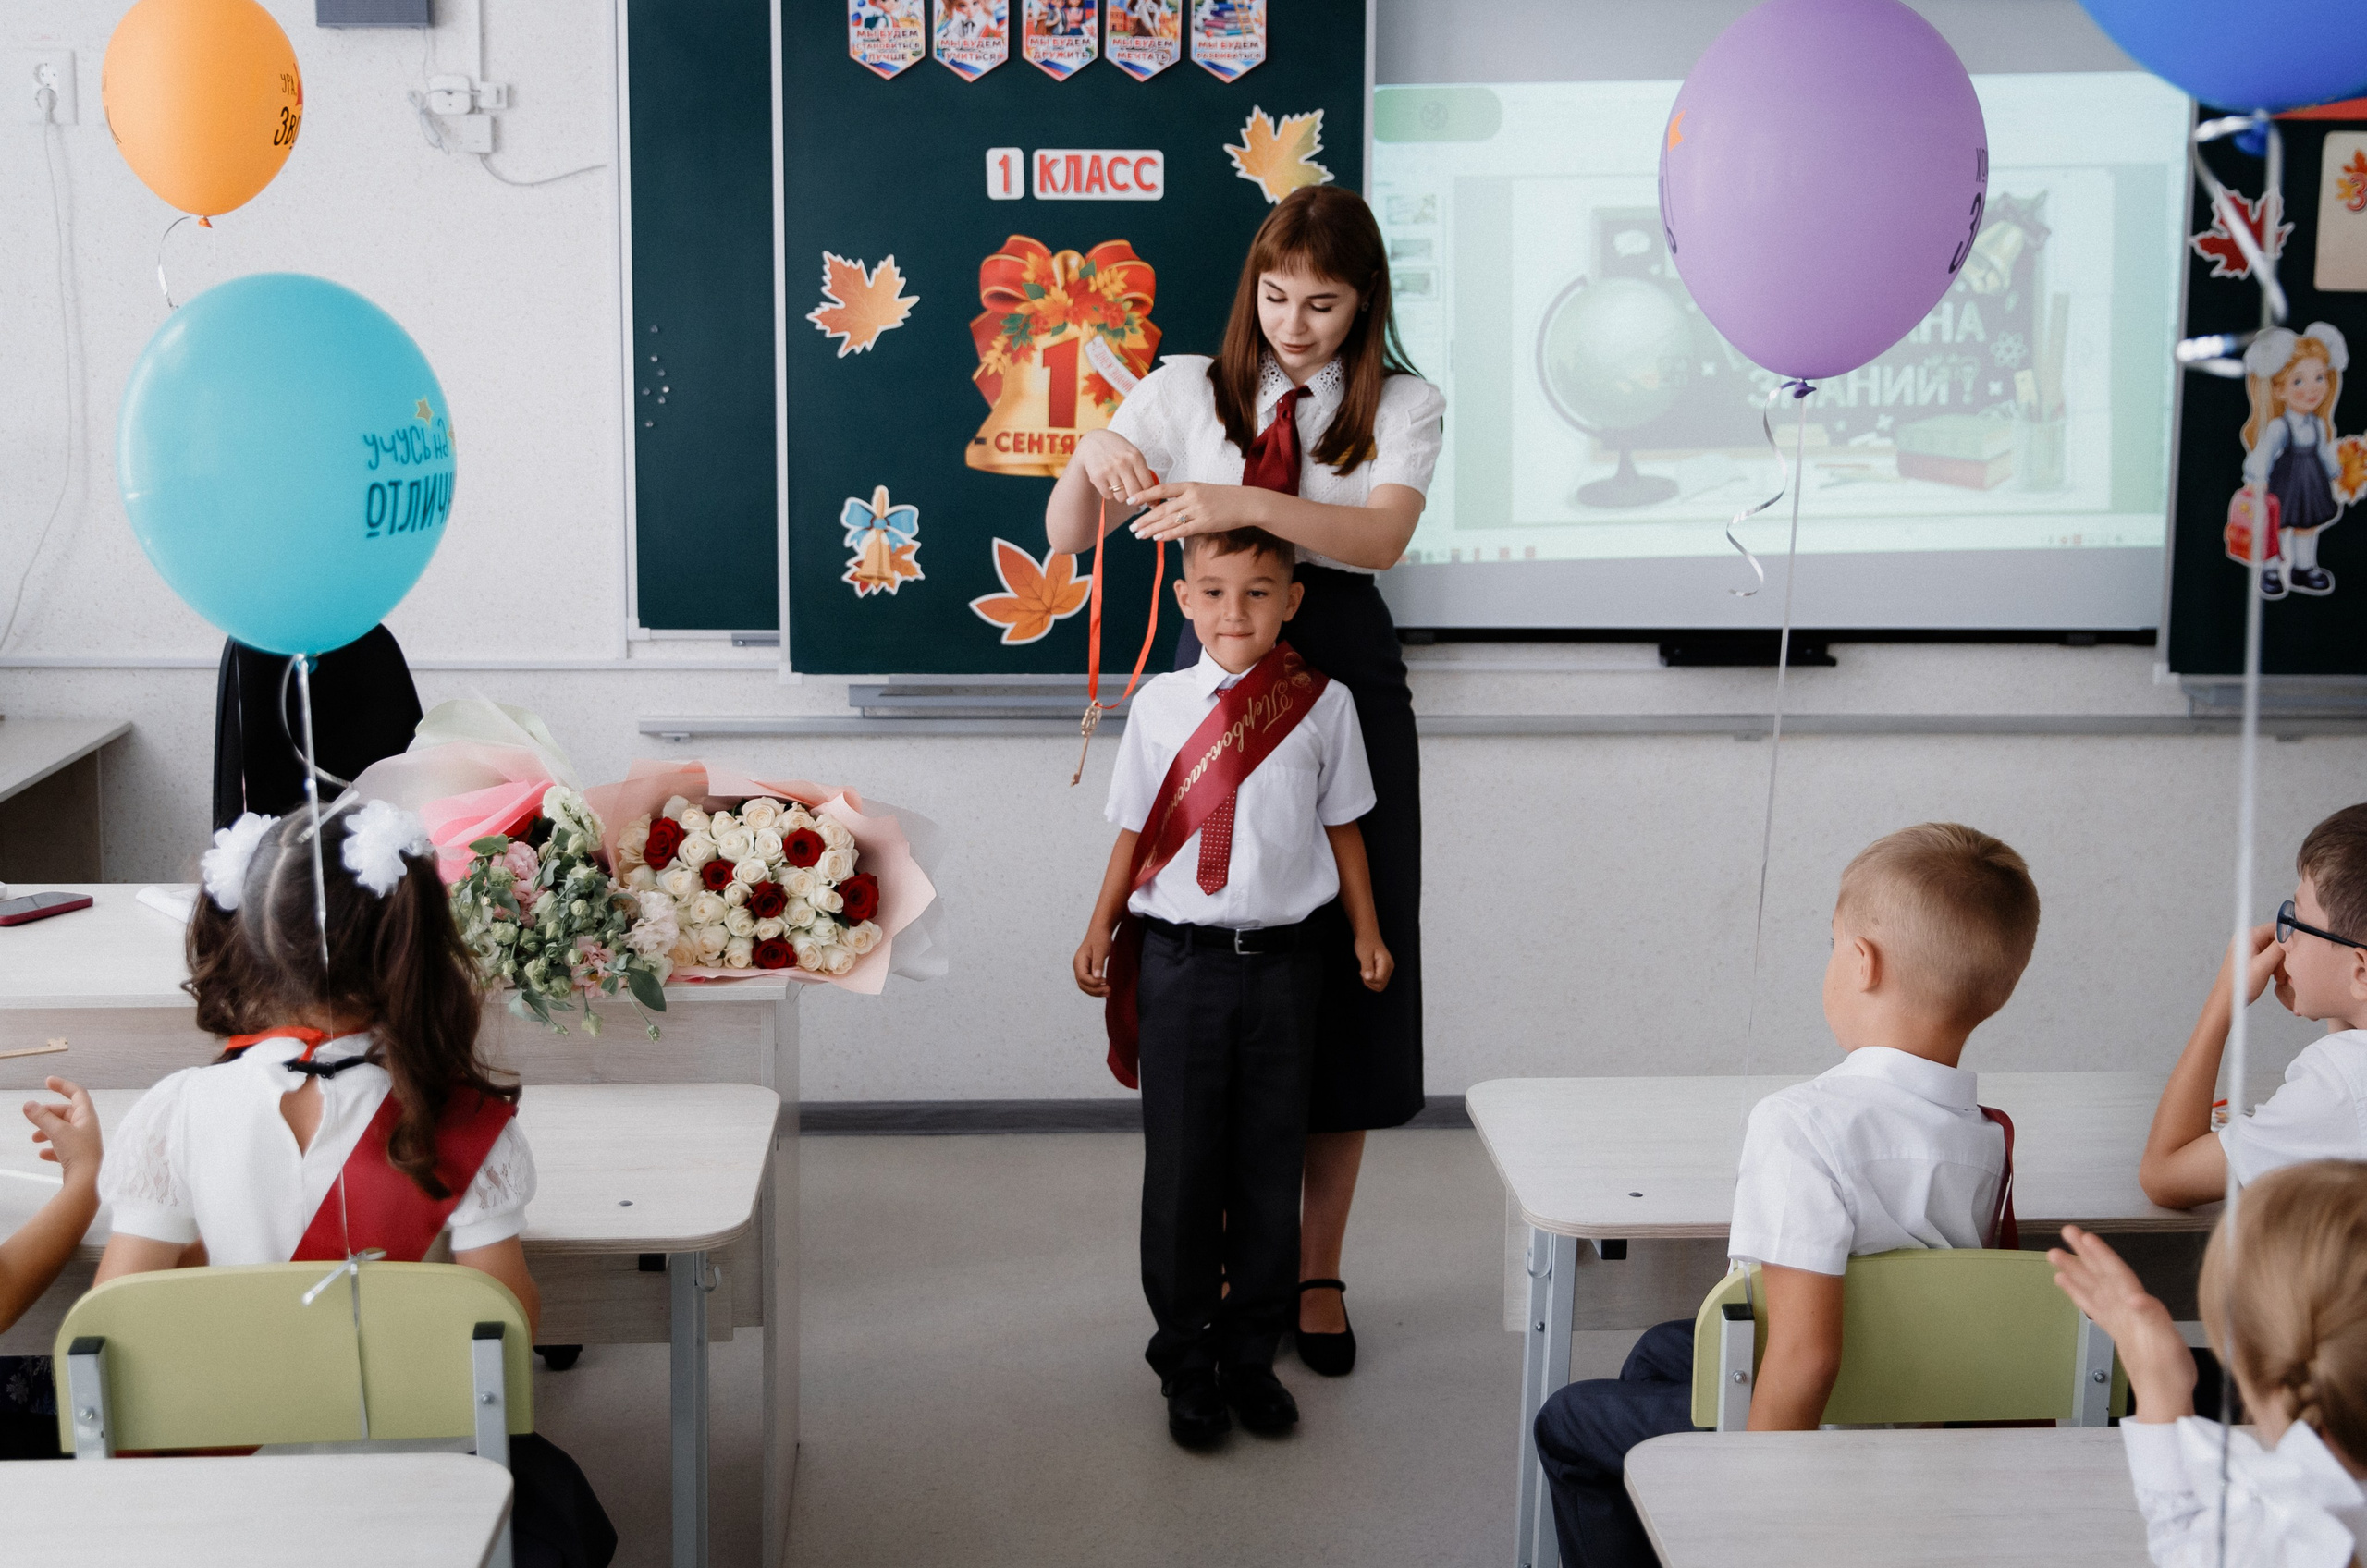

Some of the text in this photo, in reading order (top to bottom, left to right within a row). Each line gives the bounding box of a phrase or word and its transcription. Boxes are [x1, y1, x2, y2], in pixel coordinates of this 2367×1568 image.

[856, 30, 919, 39] МЫ БУДЕМ
[1029, 38, 1091, 47] МЫ БУДЕМ
[1112, 38, 1174, 48] МЫ БУДЕМ
[939, 39, 1002, 49] МЫ БУДЕМ
[1197, 41, 1260, 51] МЫ БУДЕМ
[945, 52, 997, 61] УЧИТЬСЯ
[998, 153, 1159, 194] 1 КЛАСС
[1909, 300, 1987, 344] НА
[1042, 337, 1080, 430] 1
[362, 425, 432, 471] УЧУСЬ
[994, 430, 1082, 456] СЕНТЯ
[365, 472, 453, 539] ОТЛИЧ
